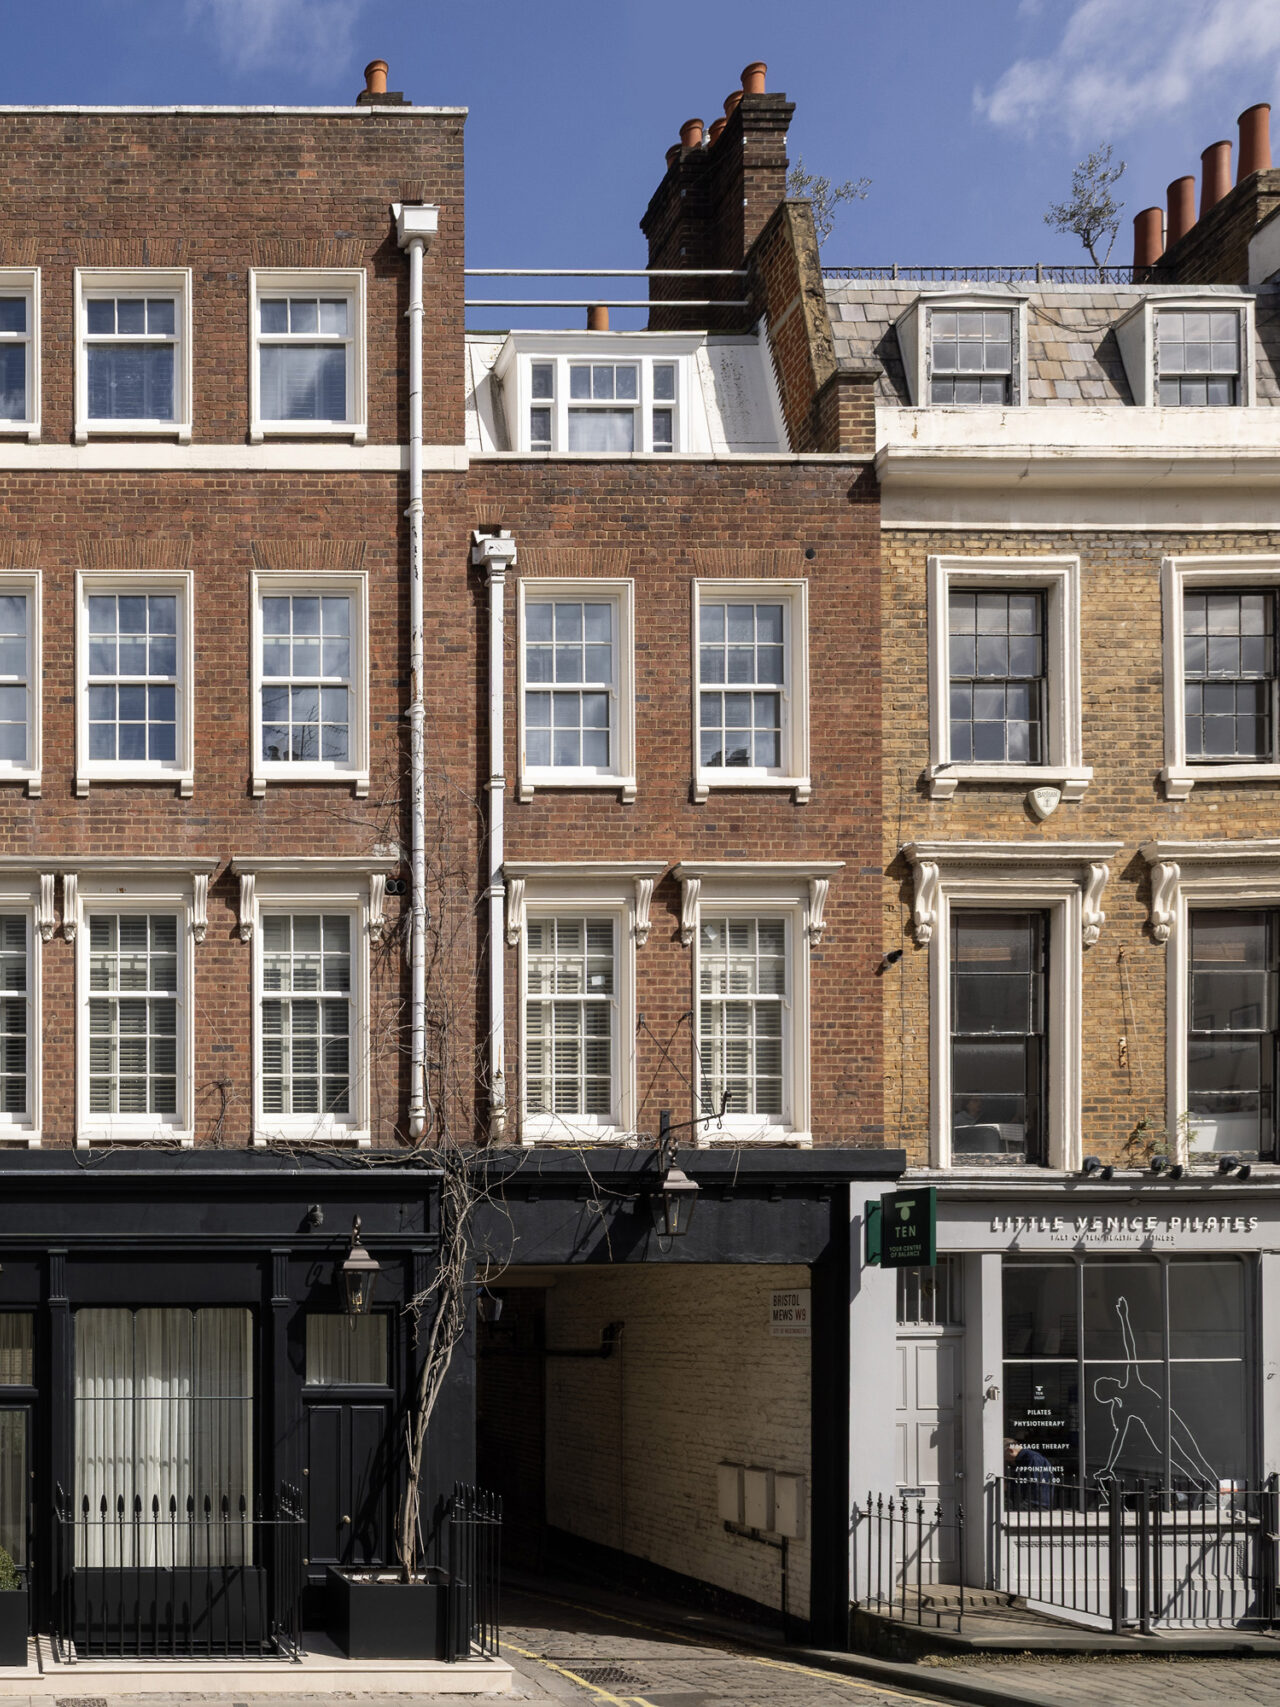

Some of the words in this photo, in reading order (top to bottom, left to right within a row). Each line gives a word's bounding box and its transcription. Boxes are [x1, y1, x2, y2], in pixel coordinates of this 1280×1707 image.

[994, 1216, 1064, 1229] LITTLE
[1077, 1216, 1157, 1229] VENICE
[1171, 1216, 1258, 1229] PILATES
[895, 1225, 916, 1238] TEN
[773, 1294, 800, 1306] BRISTOL
[772, 1309, 793, 1320] MEWS
[795, 1308, 807, 1320] W9
